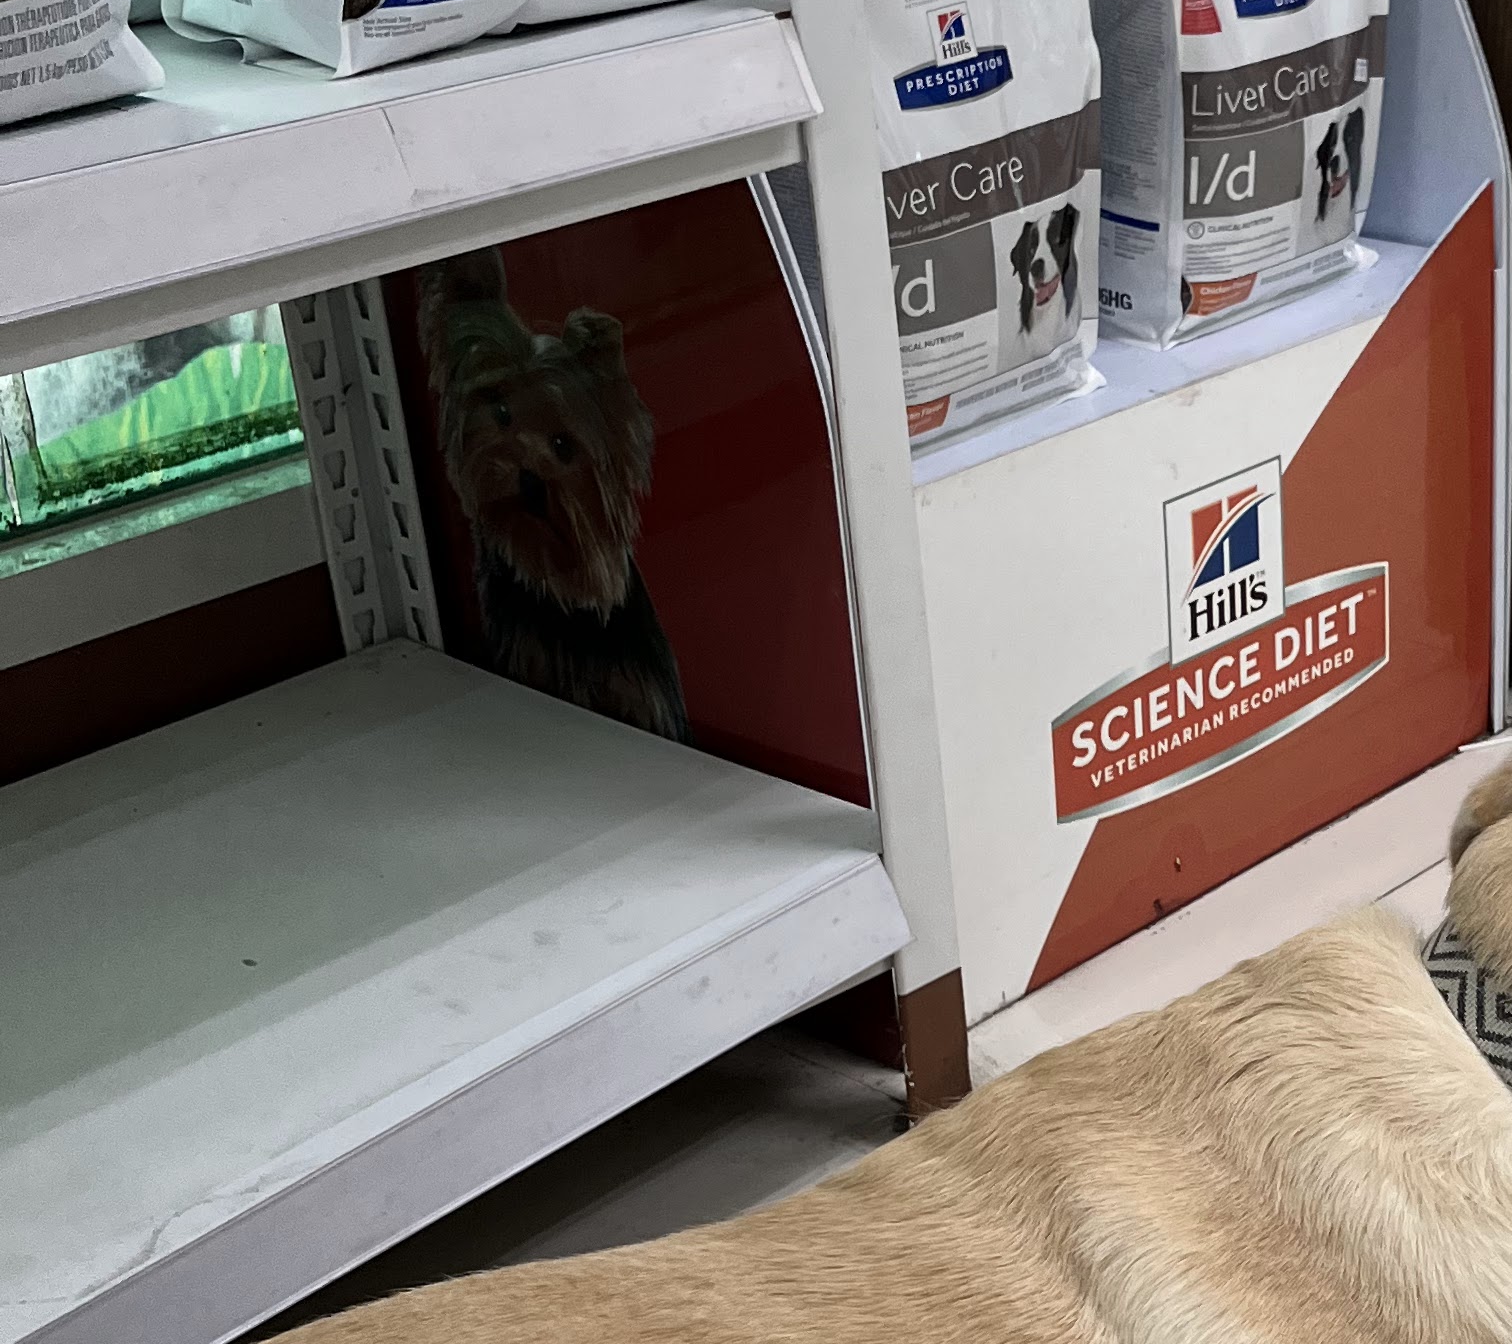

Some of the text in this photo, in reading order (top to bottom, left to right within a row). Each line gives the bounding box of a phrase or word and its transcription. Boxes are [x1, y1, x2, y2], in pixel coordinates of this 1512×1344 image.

[905, 56, 1003, 93] PRESCRIPTION
[941, 40, 972, 59] Hill's
[947, 77, 980, 97] DIET
[1191, 64, 1331, 117] Liver Care
[887, 156, 1025, 220] ver Care
[1188, 149, 1256, 205] l/d
[1187, 573, 1268, 641] Hill's
[1071, 592, 1365, 769] SCIENCE DIET
[1090, 648, 1355, 788] VETERINARIAN RECOMMENDED
